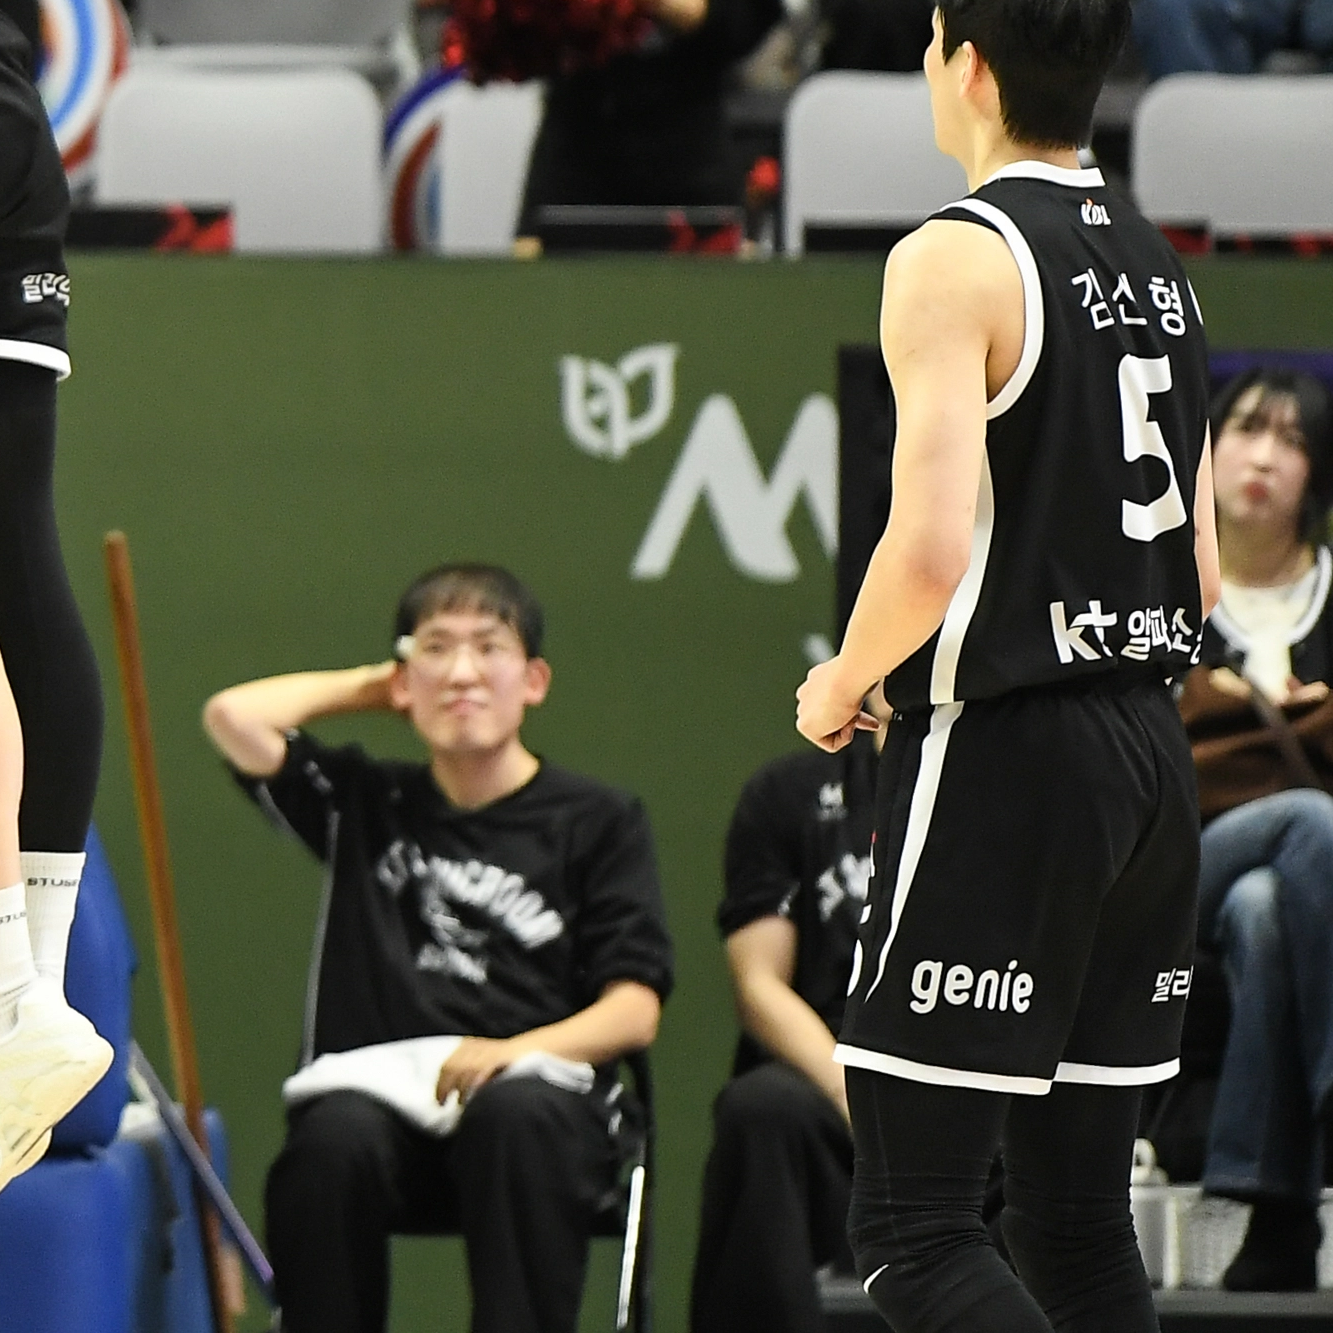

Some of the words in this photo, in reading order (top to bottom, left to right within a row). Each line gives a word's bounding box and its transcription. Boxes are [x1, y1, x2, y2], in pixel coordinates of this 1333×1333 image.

[1071, 267, 1187, 337] 김선형
[1117, 353, 1189, 542] 5
[909, 959, 1034, 1014] genie
